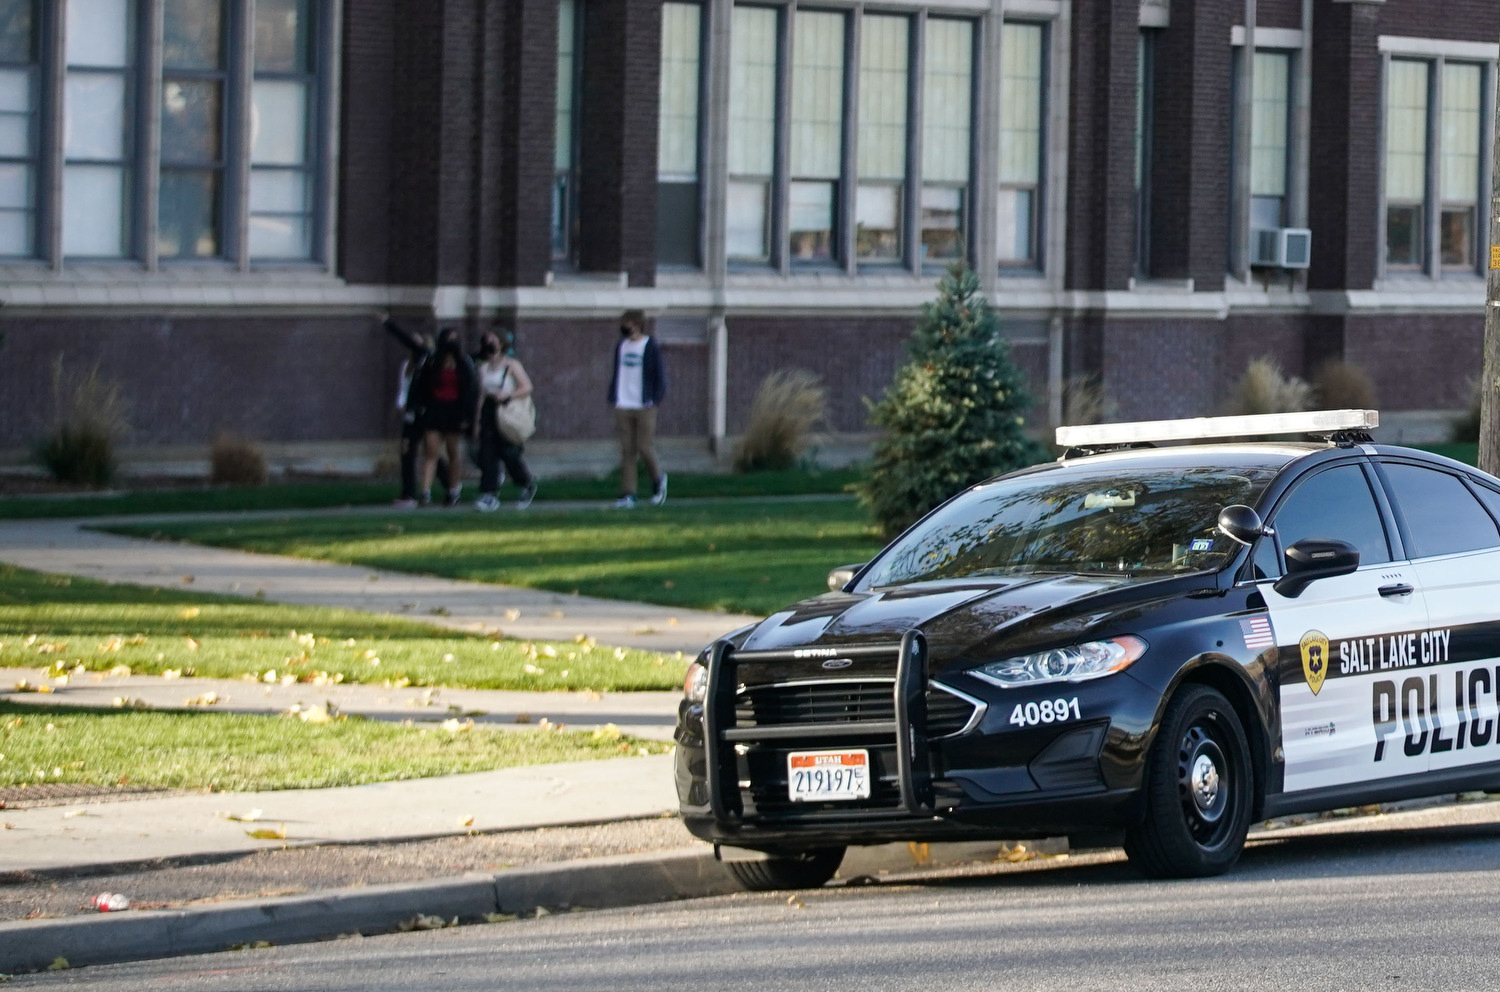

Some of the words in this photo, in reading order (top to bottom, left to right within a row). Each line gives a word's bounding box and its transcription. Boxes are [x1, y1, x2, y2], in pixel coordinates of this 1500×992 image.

[1340, 638, 1375, 674] SALT
[1379, 634, 1416, 669] LAKE
[1421, 629, 1450, 664] CITY
[1009, 696, 1081, 727] 40891
[815, 755, 842, 765] UTAH
[795, 768, 853, 793] 219197
